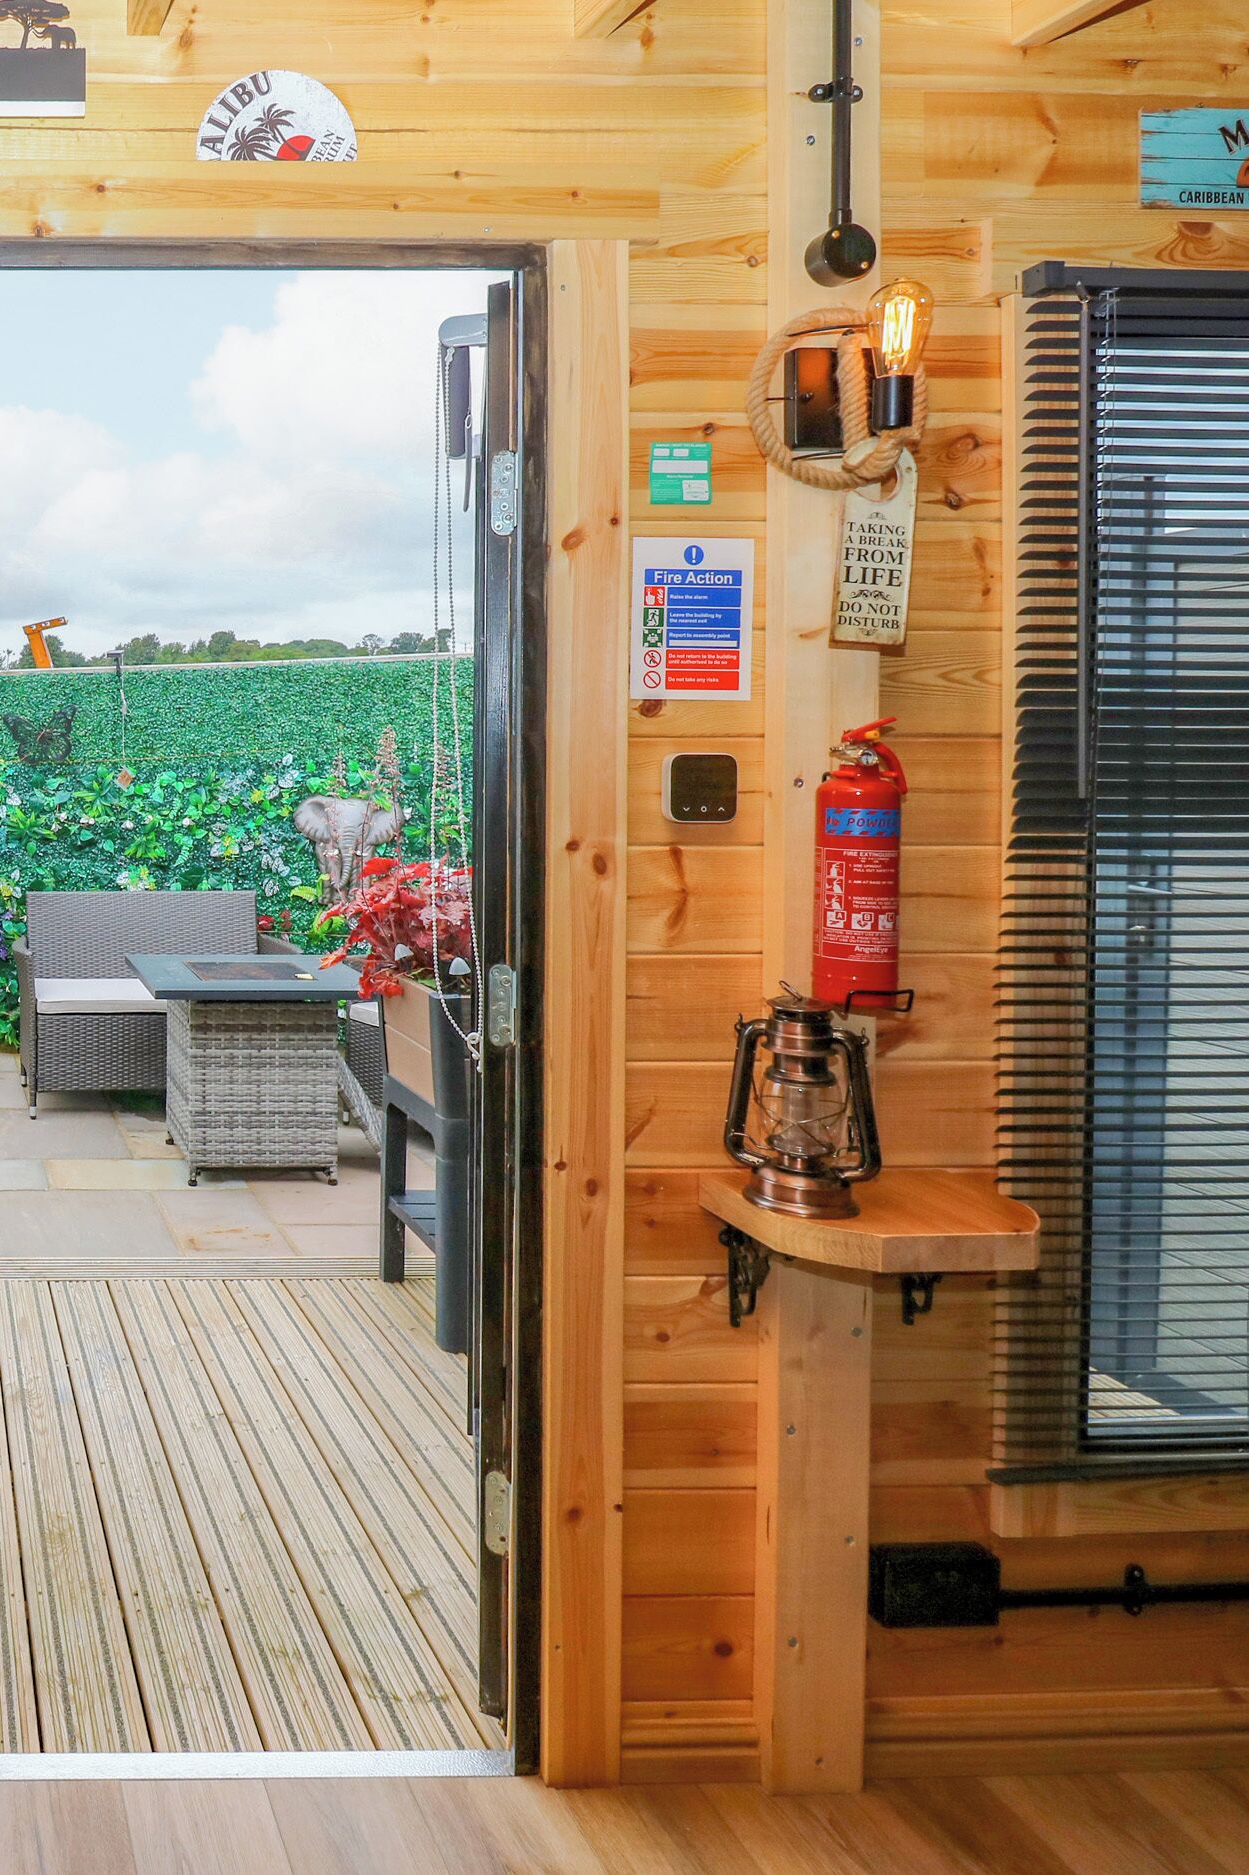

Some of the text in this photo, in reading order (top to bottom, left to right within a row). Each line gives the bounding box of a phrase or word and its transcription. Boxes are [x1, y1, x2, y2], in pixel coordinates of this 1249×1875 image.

[200, 71, 272, 160] ALIBU
[1179, 191, 1244, 204] CARIBBEAN
[846, 521, 905, 536] TAKING
[845, 535, 905, 548] A BREAK
[843, 547, 905, 565] FROM
[654, 570, 733, 584] Fire Action
[843, 565, 902, 587] LIFE
[839, 601, 901, 616] DO NOT
[837, 615, 900, 630] DISTURB
